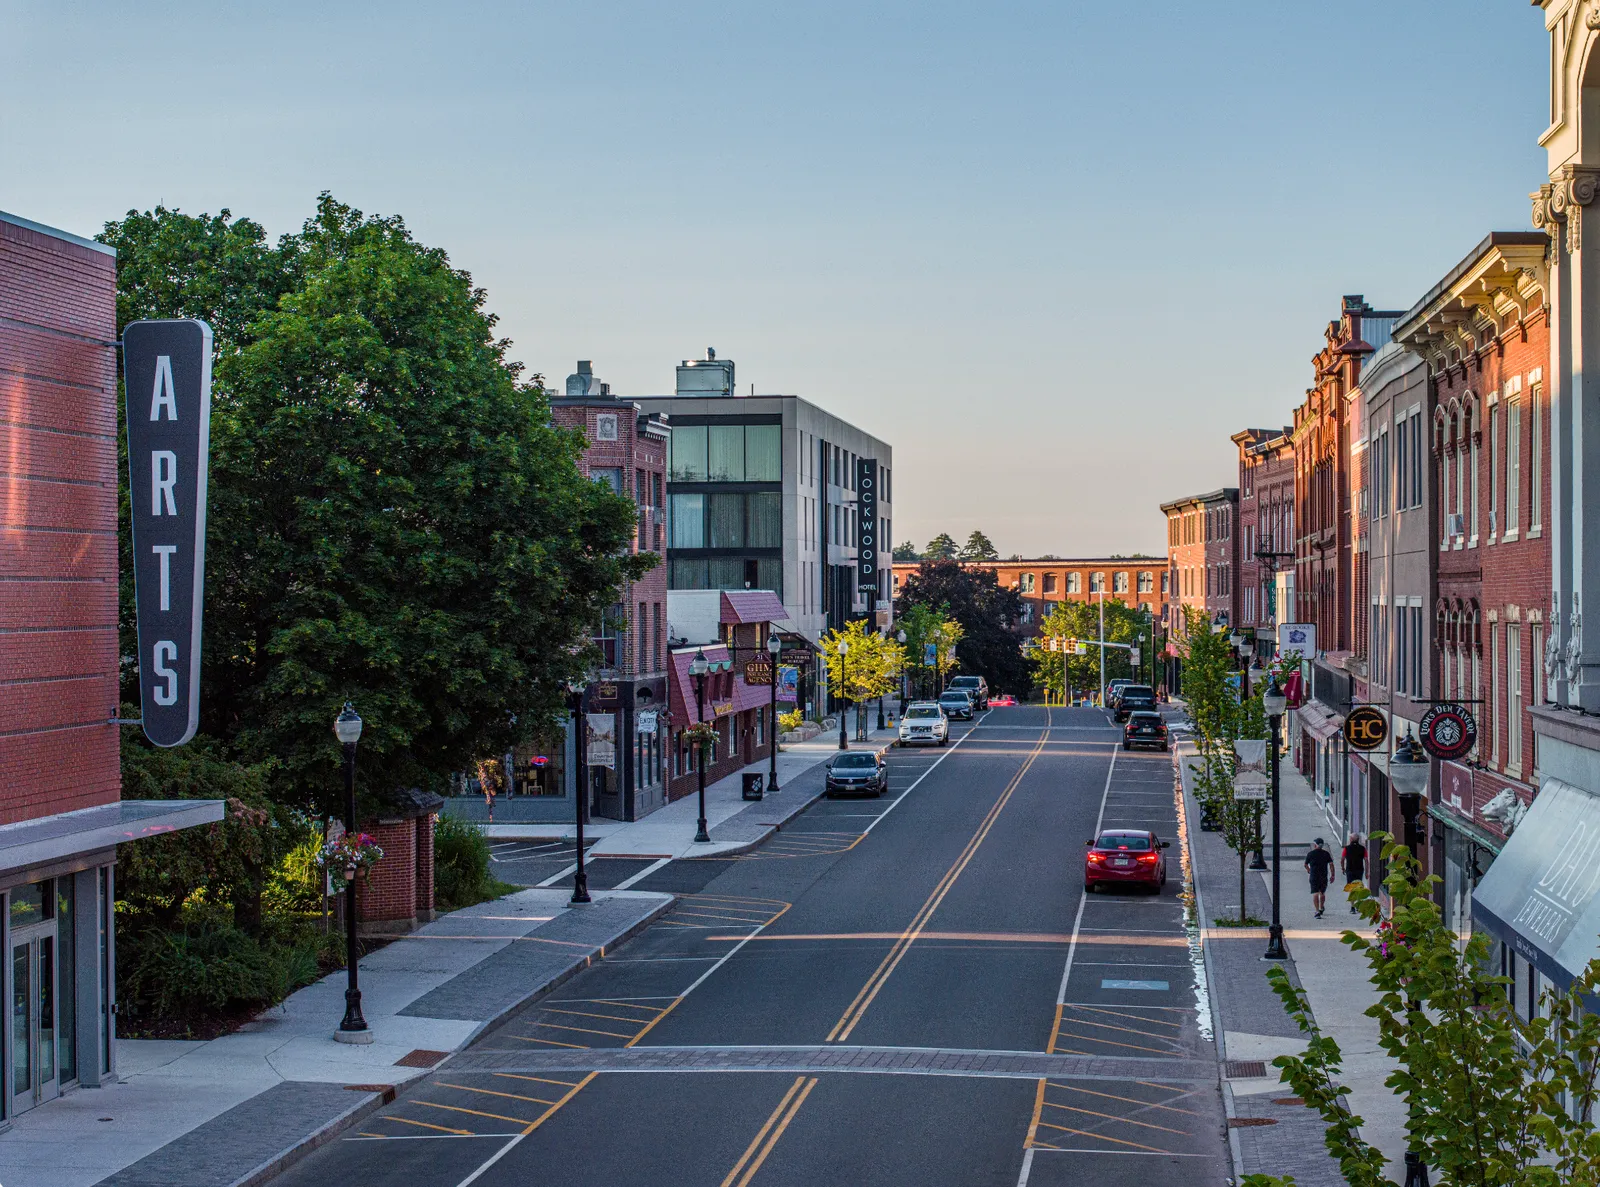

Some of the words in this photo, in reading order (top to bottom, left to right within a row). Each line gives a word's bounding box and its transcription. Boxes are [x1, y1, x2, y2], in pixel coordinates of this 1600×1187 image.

[149, 355, 178, 706] ARTS
[862, 464, 872, 574] LOCKWOOD
[1349, 719, 1383, 739] HC
[1420, 712, 1435, 735] LION'S
[1436, 705, 1453, 713] DEN
[1456, 706, 1475, 735] TAVERN
[1513, 895, 1567, 944] JEWELERS
